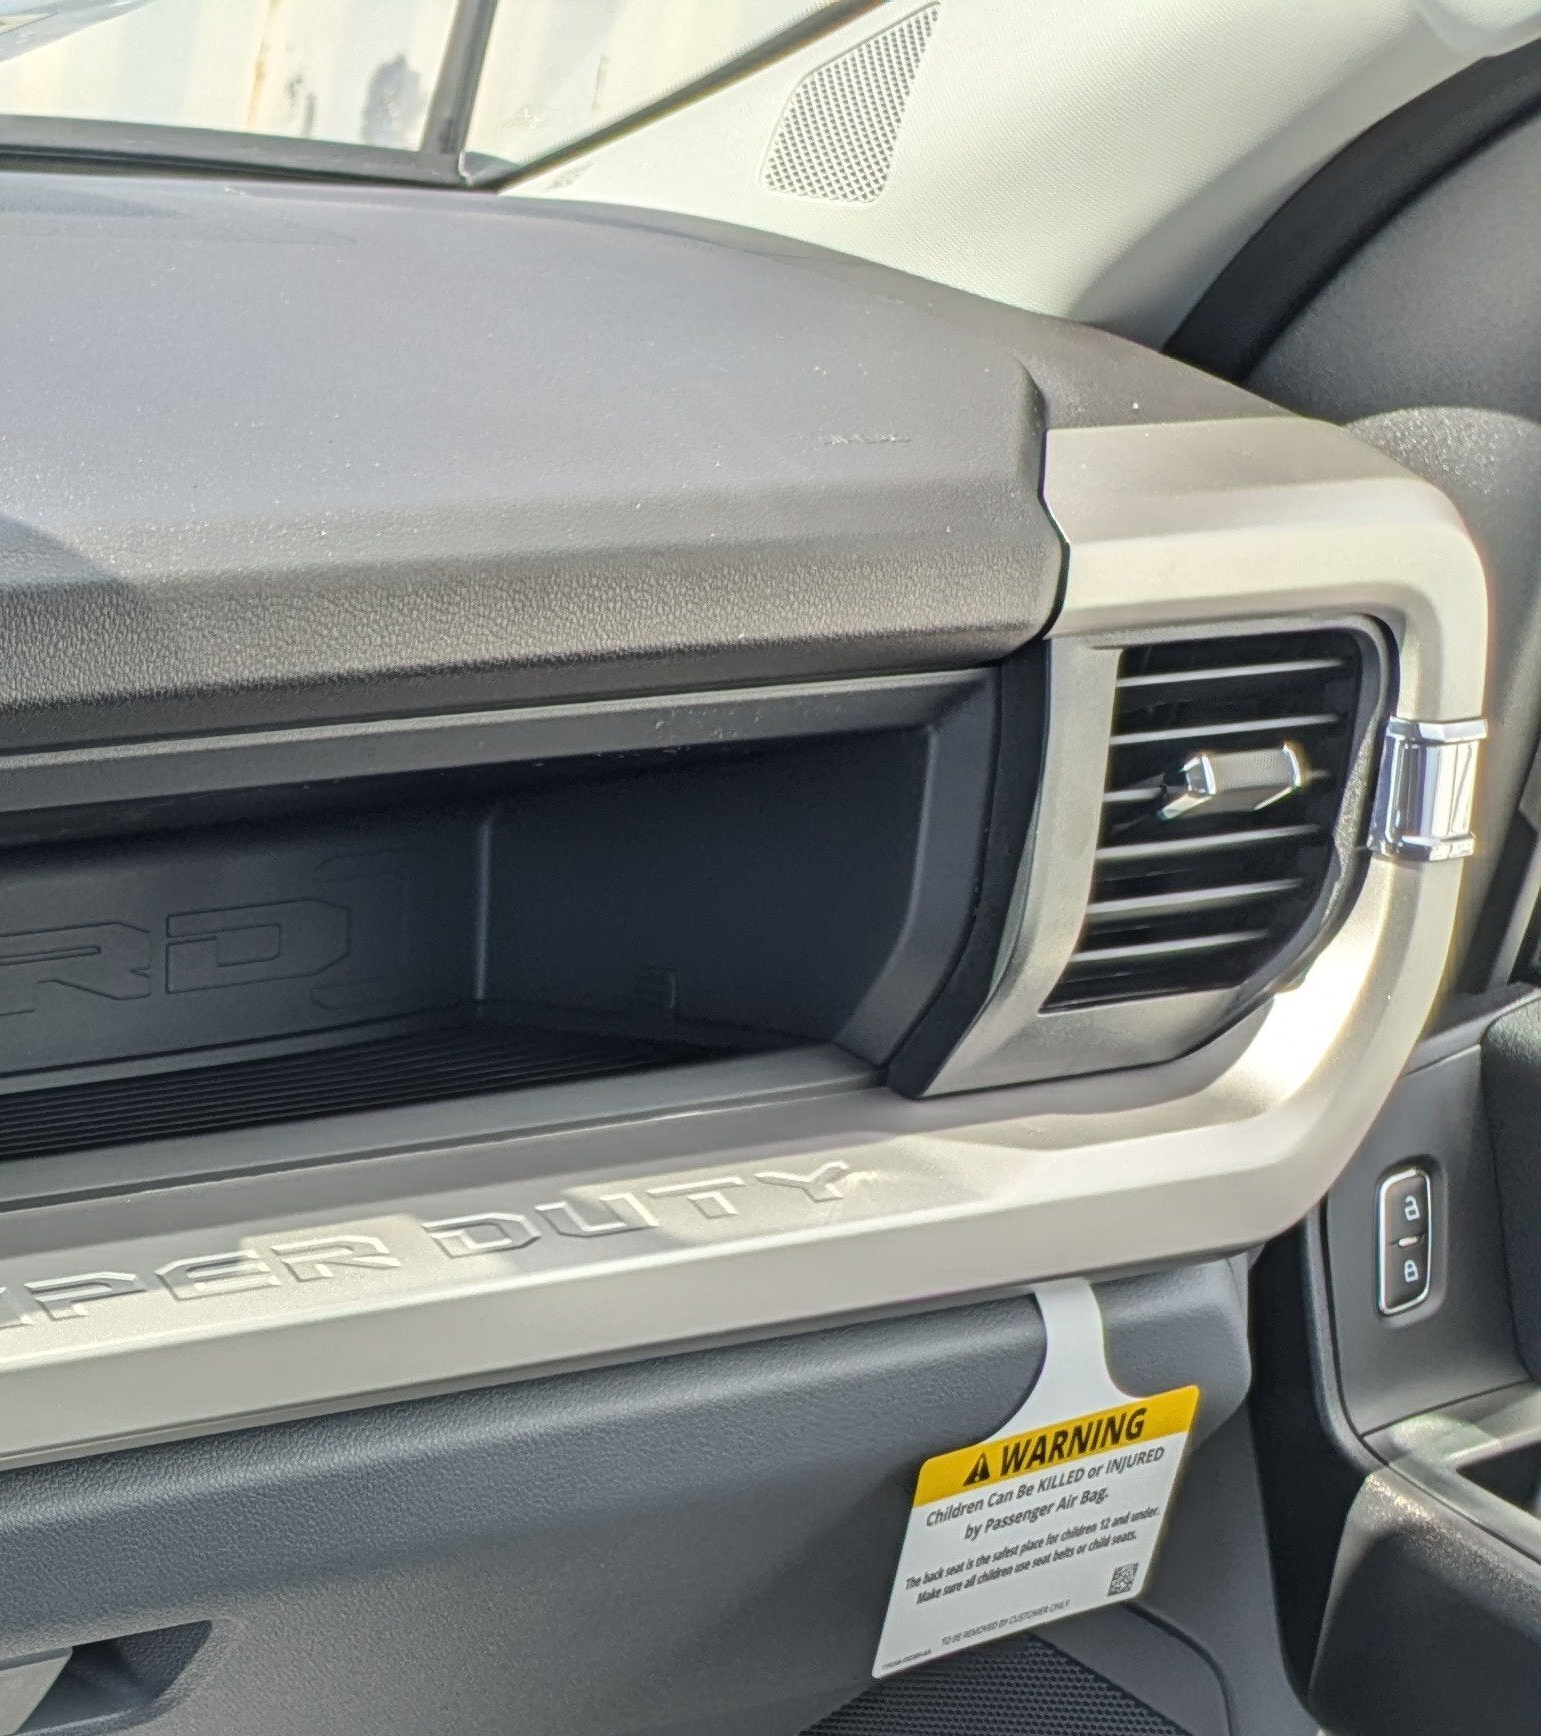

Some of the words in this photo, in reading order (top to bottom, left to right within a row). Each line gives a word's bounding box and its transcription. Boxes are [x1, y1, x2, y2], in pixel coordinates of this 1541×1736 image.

[420, 1160, 860, 1260] DUTY
[1000, 1407, 1148, 1478] WARNING
[926, 1499, 985, 1528] Children
[988, 1490, 1013, 1510] Can
[1016, 1482, 1034, 1500] Be
[1036, 1466, 1084, 1494] KILLED
[1088, 1463, 1103, 1479] or
[1105, 1446, 1165, 1476] INJURED
[964, 1522, 983, 1542] by
[985, 1501, 1056, 1535] Passenger
[1057, 1493, 1078, 1514] Air
[1080, 1486, 1110, 1507] Bag.
[905, 1575, 921, 1590] The
[975, 1553, 991, 1568] the
[1045, 1532, 1060, 1546] for
[1060, 1522, 1097, 1543] children
[1112, 1510, 1130, 1527] and
[917, 1586, 942, 1605] Make
[977, 1564, 1013, 1585] children
[1088, 1534, 1110, 1551] child
